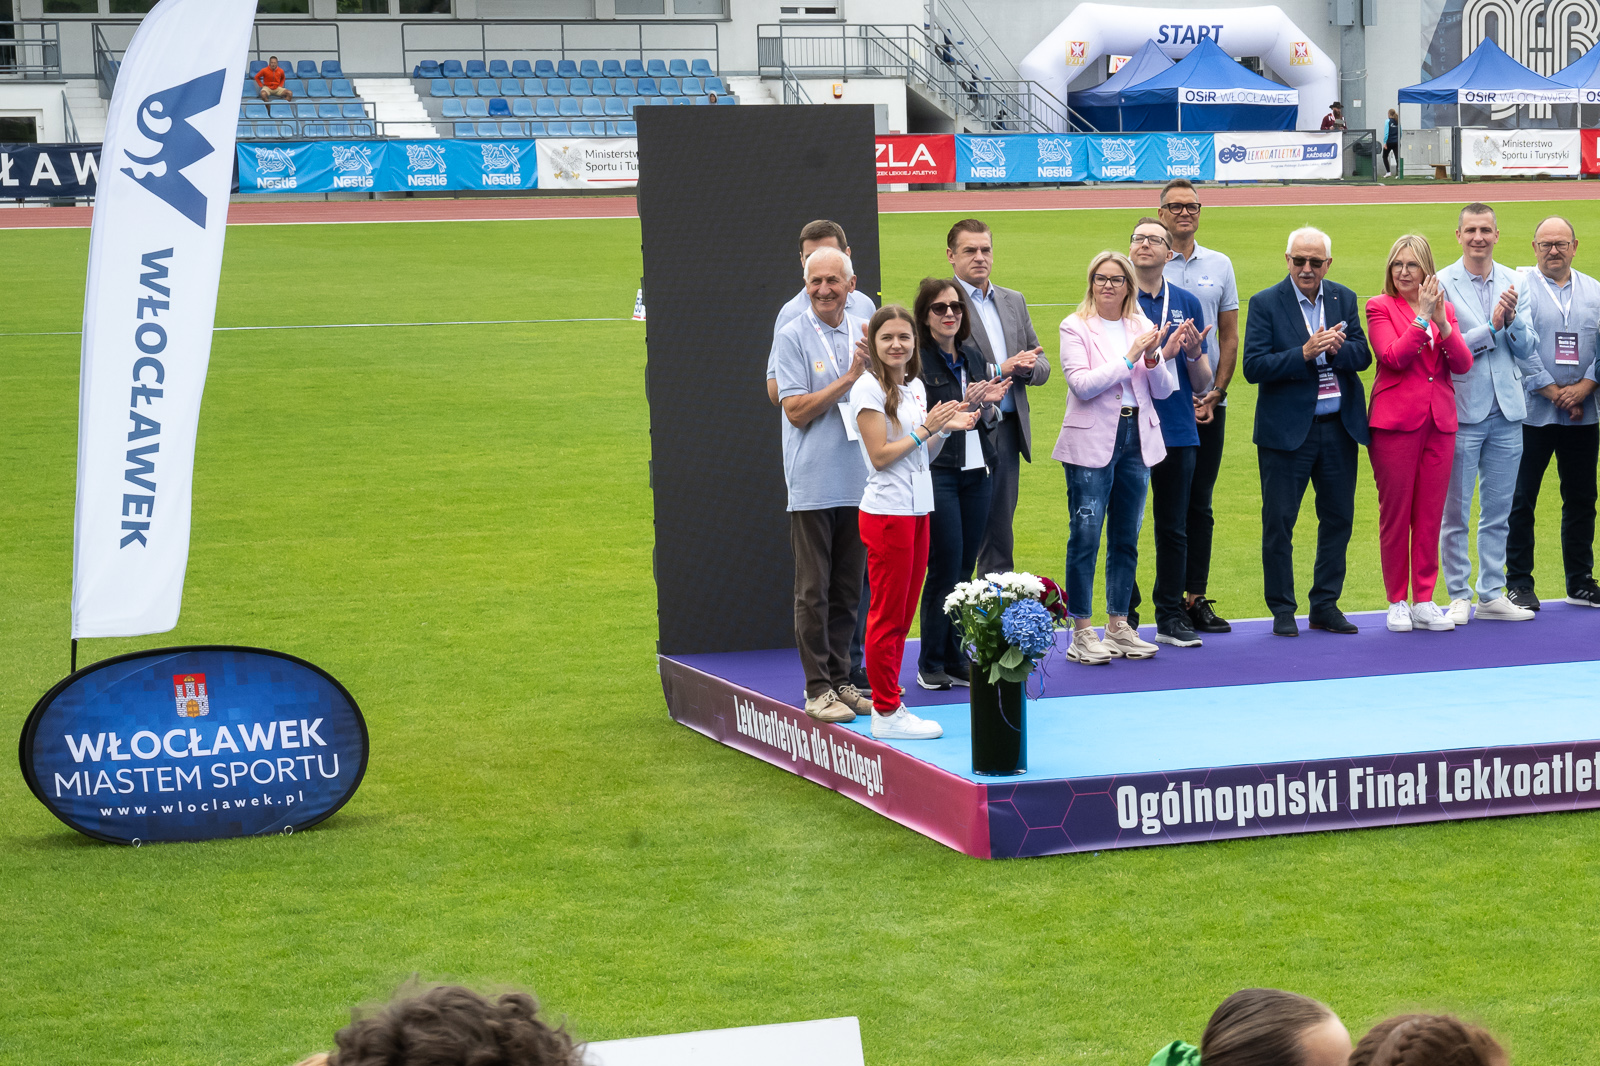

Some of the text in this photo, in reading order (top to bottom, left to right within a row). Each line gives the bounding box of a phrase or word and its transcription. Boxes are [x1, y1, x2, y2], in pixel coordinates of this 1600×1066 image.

[1157, 25, 1224, 44] START
[1185, 91, 1291, 103] OSiR WŁOCŁAWEK
[1465, 92, 1571, 102] OSiR WŁOCŁAWEK
[1502, 139, 1553, 149] Ministerstwo
[875, 143, 936, 168] ZLA
[1248, 148, 1301, 160] LEKKOATLETYKA
[1502, 151, 1528, 161] Sportu
[1535, 150, 1569, 161] Turystyki
[586, 161, 617, 171] Sportu
[971, 166, 1006, 178] Nestlé
[1038, 166, 1072, 178] Nestlé
[1102, 166, 1136, 177] Nestlé
[1167, 165, 1200, 176] Nestlé
[257, 177, 297, 188] Nestlé
[334, 175, 374, 187] Nestlé
[408, 174, 447, 186] Nestlé
[482, 173, 521, 185] Nestlé
[119, 247, 174, 550] WŁOCŁAWEK
[64, 718, 327, 763] WŁOCŁAWEK
[734, 695, 884, 797] Lekkoatletyka dla każdego!
[54, 753, 340, 798] MIASTEM SPORTU
[100, 791, 304, 817] www.wloclawek.pl
[1116, 770, 1338, 835] Ogólnopolski
[1348, 763, 1428, 810] Finał
